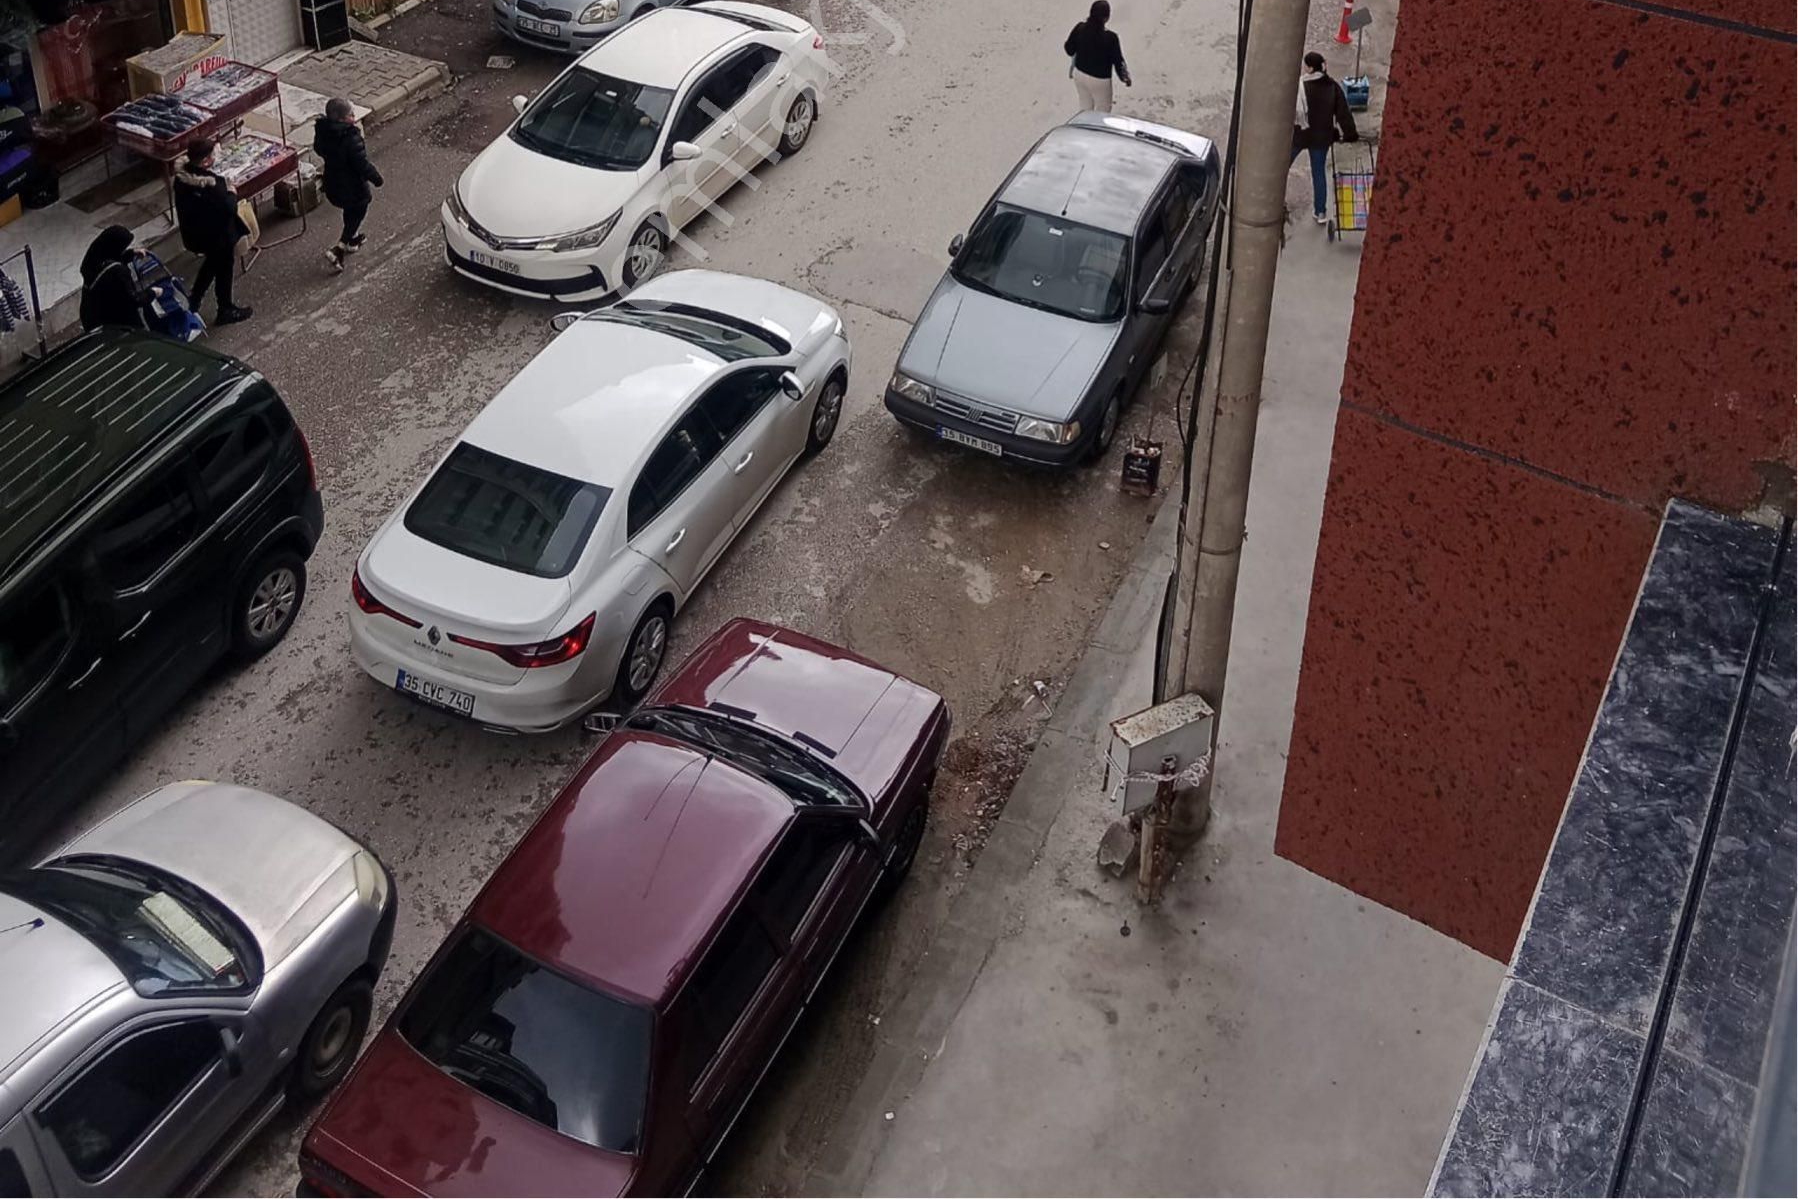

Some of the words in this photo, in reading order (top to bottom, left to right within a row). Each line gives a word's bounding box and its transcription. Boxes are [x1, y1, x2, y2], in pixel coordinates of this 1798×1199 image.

[405, 673, 419, 691] 35
[422, 681, 444, 701] CVC
[449, 690, 471, 711] 740
